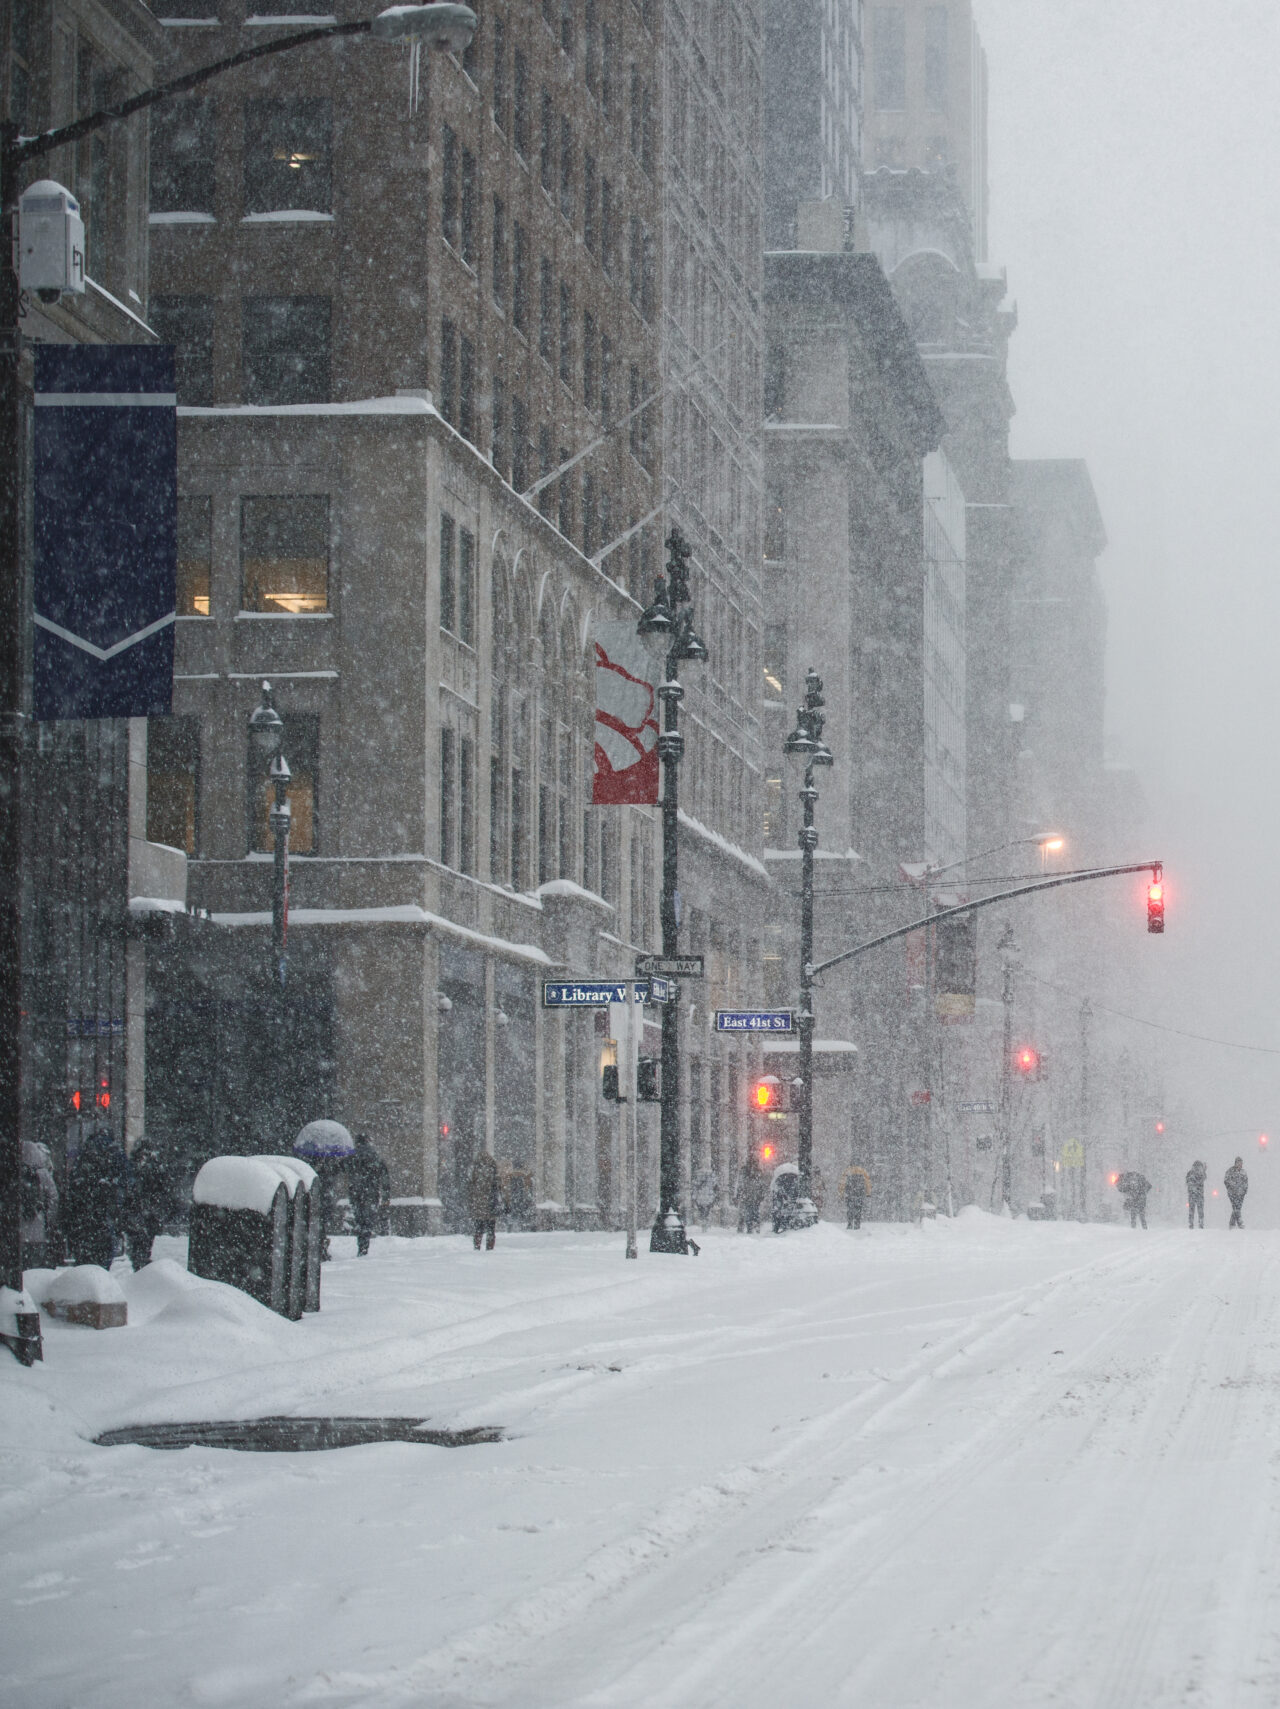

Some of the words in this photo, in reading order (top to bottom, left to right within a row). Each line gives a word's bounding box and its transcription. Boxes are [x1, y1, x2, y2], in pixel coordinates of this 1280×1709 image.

[645, 961, 664, 971] ONE
[676, 961, 696, 971] WAY
[561, 988, 613, 1003] Library
[724, 1017, 747, 1027] East
[749, 1017, 771, 1027] 41st
[774, 1017, 786, 1027] St
